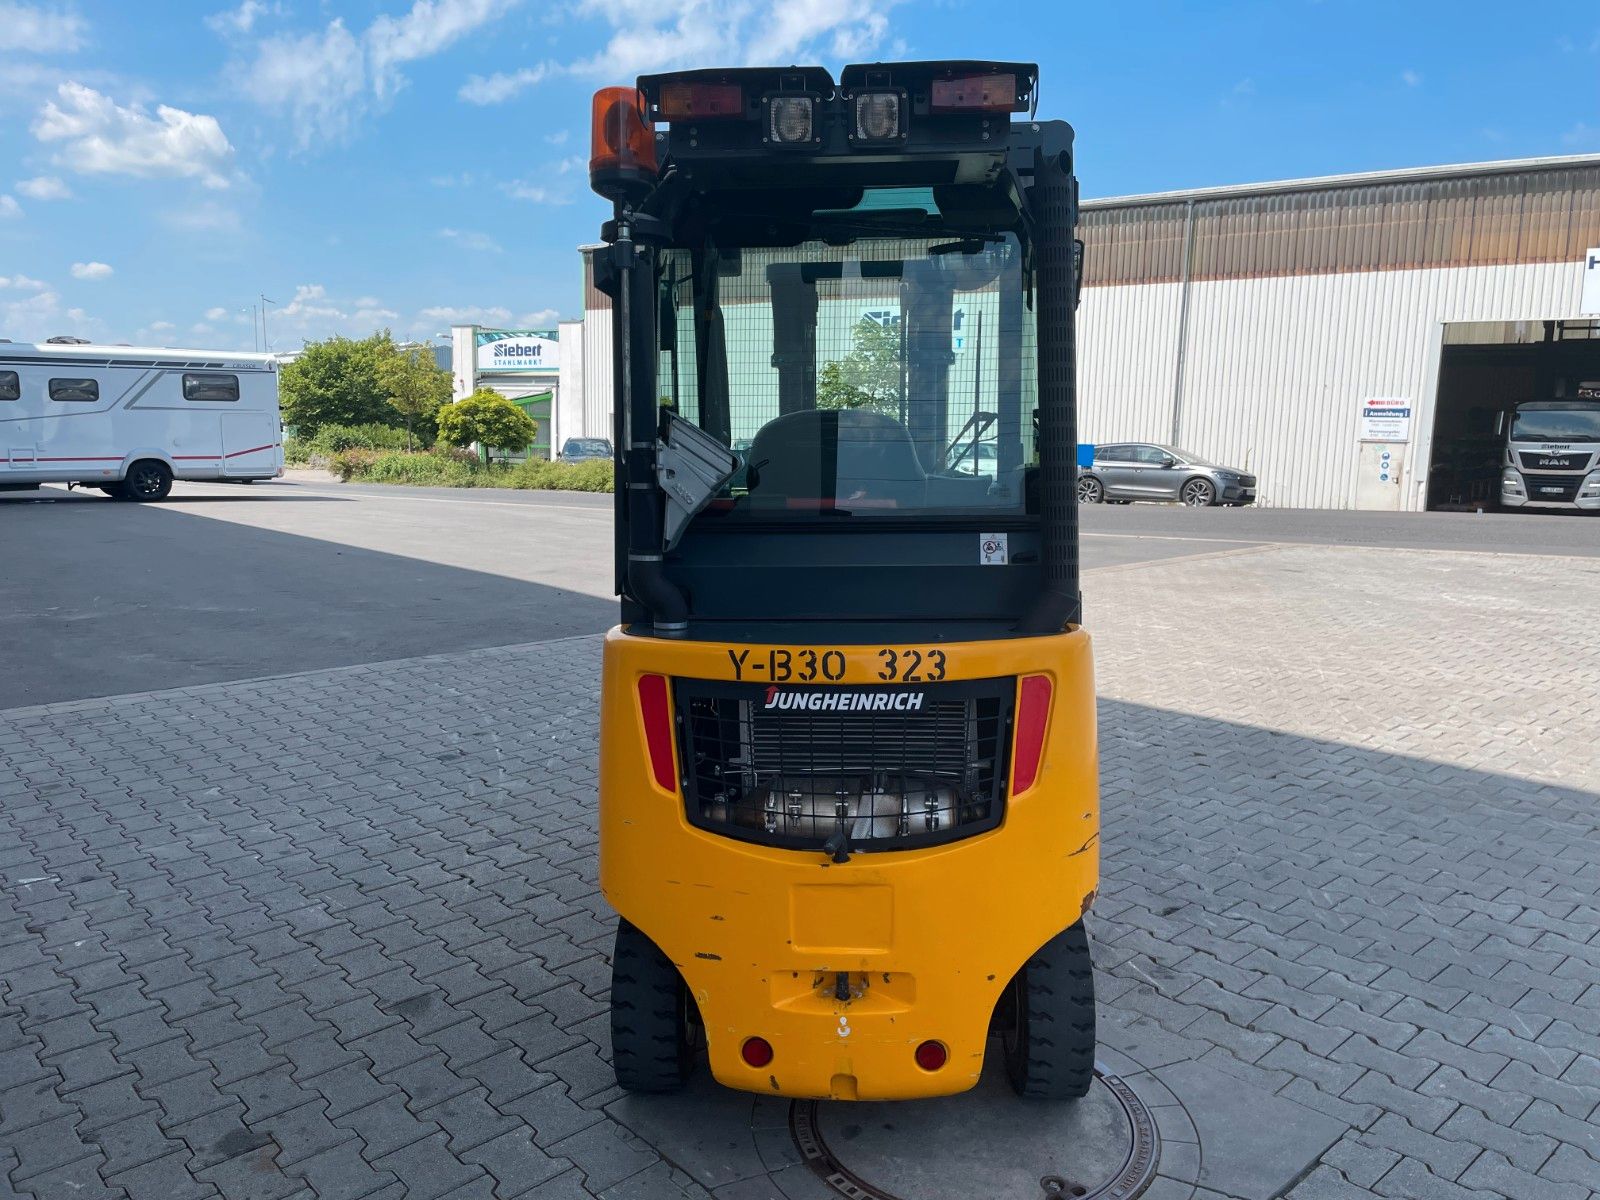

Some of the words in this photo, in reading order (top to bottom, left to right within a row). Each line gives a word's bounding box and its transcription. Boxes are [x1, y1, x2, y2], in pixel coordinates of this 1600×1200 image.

[494, 343, 542, 357] Siebert
[1369, 410, 1404, 418] Anmeldung
[878, 649, 947, 682] 323
[764, 691, 924, 711] JUNGHEINRICH
